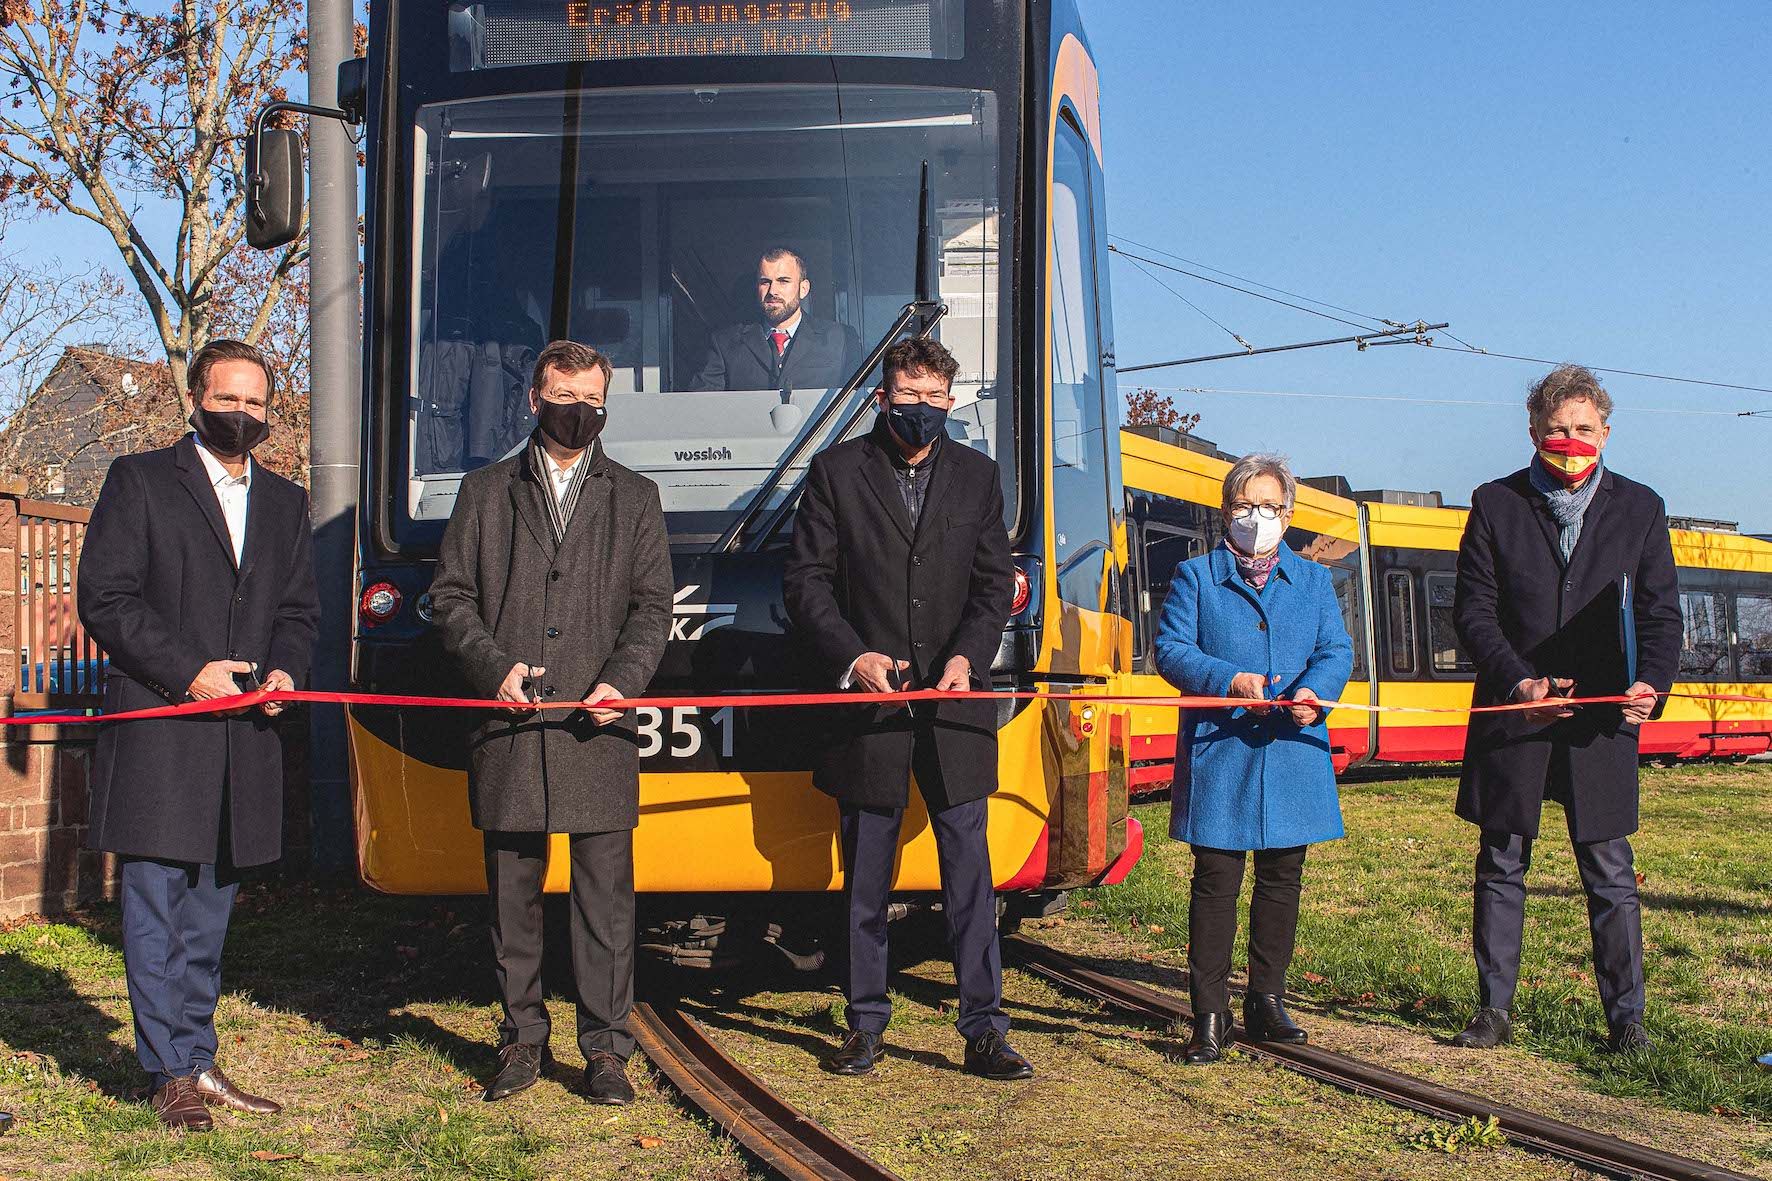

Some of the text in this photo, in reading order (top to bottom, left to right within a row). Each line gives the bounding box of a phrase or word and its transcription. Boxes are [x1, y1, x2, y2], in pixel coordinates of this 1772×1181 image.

[568, 0, 851, 27] Eröffnungszug
[763, 28, 833, 52] Nord
[674, 446, 732, 461] vossloh
[636, 706, 734, 757] 351
